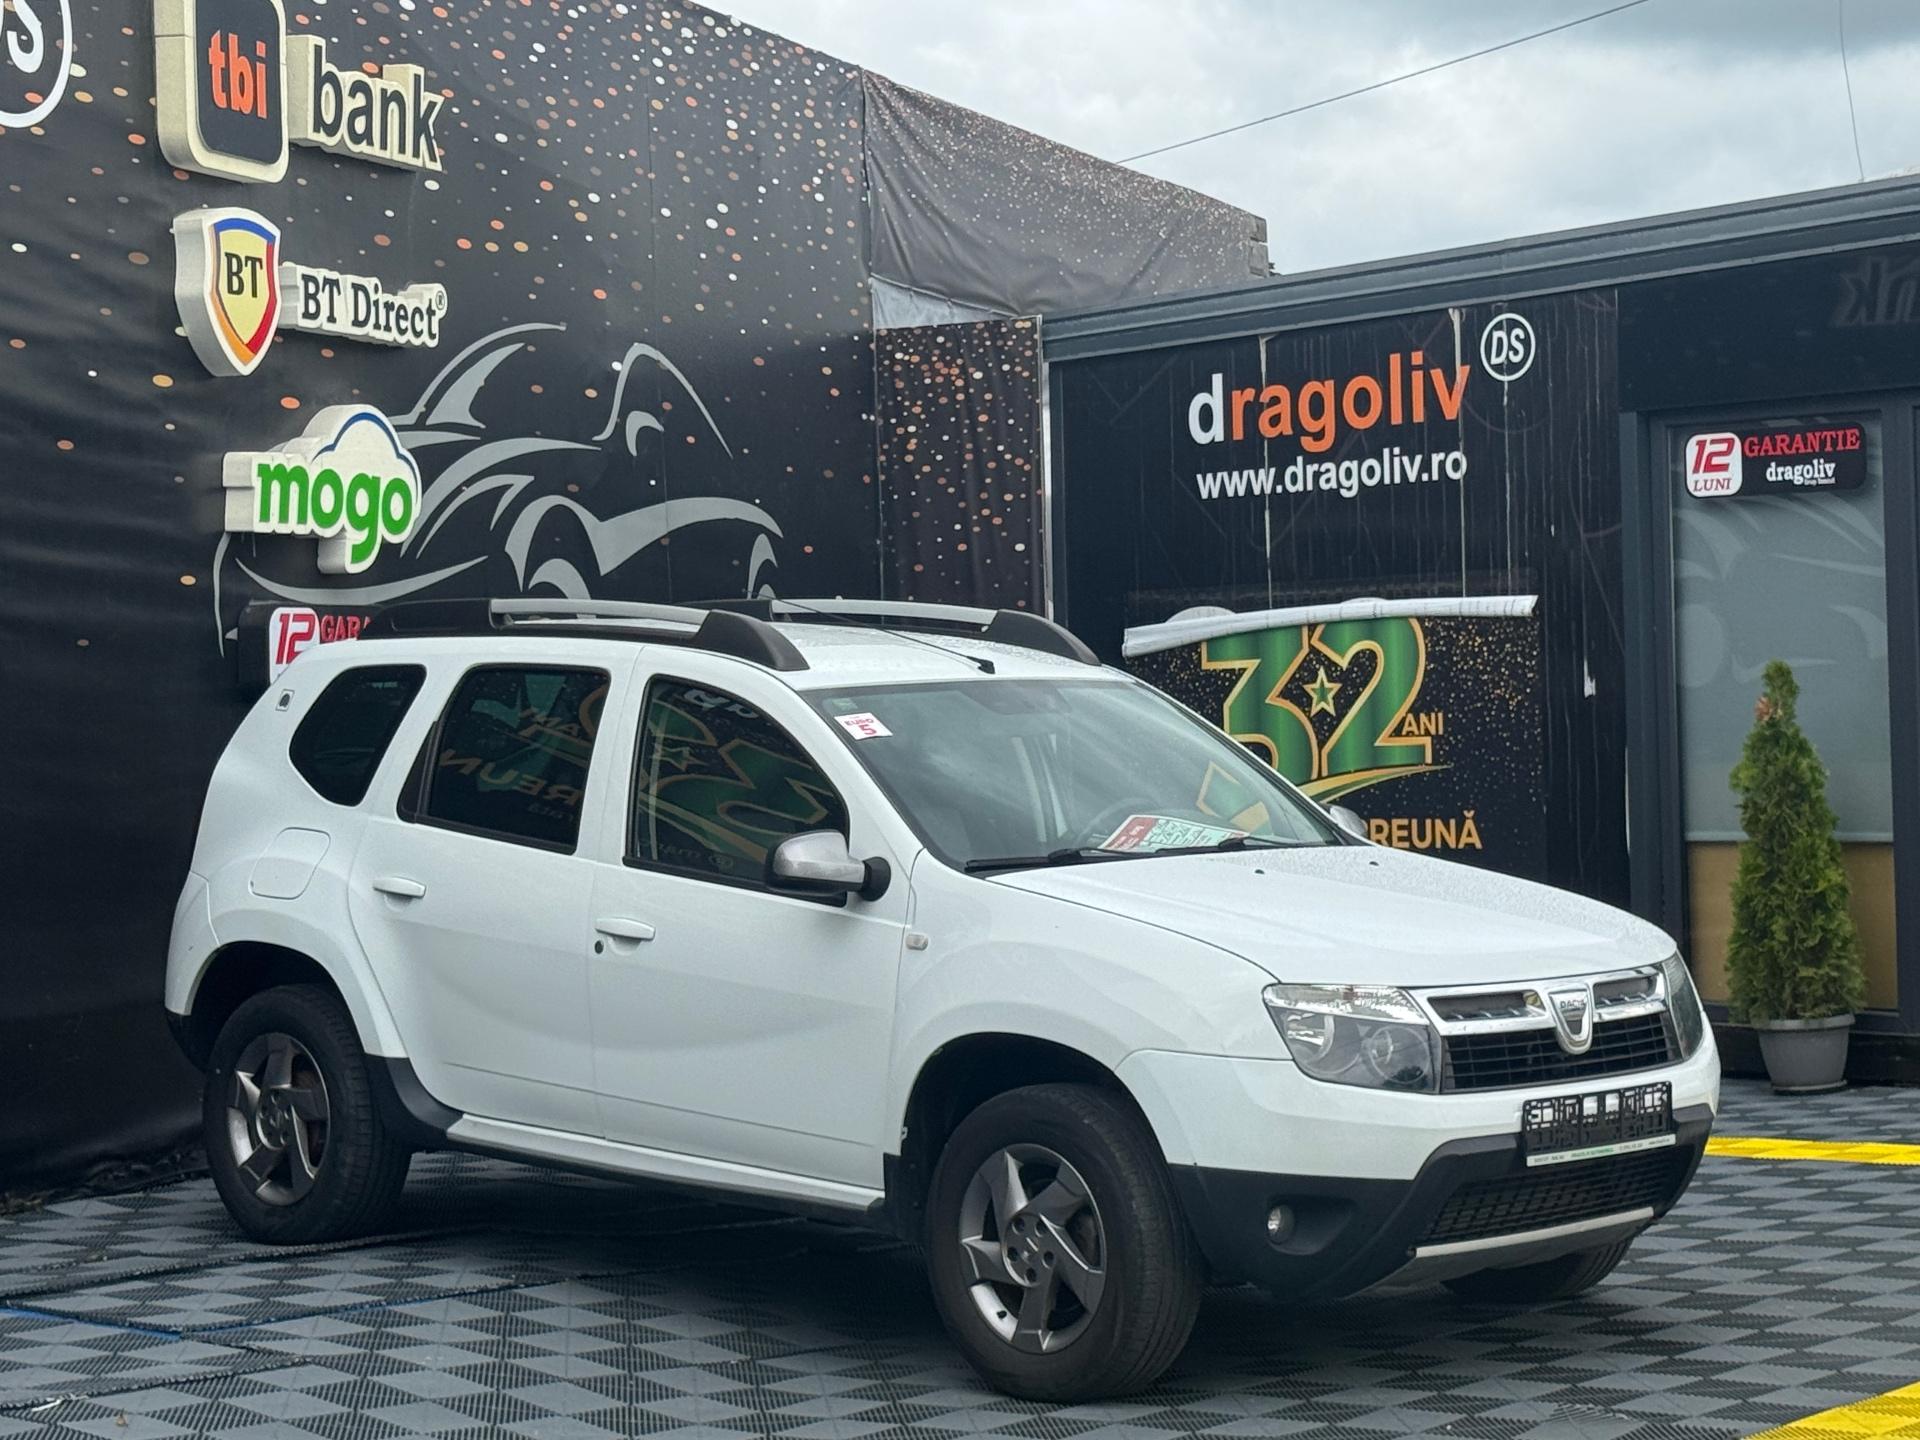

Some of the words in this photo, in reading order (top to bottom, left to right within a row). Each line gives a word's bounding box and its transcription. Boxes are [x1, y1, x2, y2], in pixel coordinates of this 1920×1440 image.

[208, 31, 268, 119] tbi
[313, 45, 442, 164] bank
[225, 252, 263, 299] BT
[301, 273, 341, 323] BT
[1491, 328, 1526, 364] DS
[1188, 350, 1470, 453] dragoliv
[1692, 438, 1735, 474] 12
[1744, 428, 1861, 457] GARANTIE
[1196, 447, 1467, 500] www.dragoliv.ro
[1693, 478, 1732, 492] LUNI
[1766, 458, 1836, 485] dragoliv
[257, 462, 412, 565] mogo
[276, 613, 316, 665] 12
[321, 614, 372, 642] GAR
[858, 723, 877, 735] 5
[1402, 712, 1444, 736] ANI
